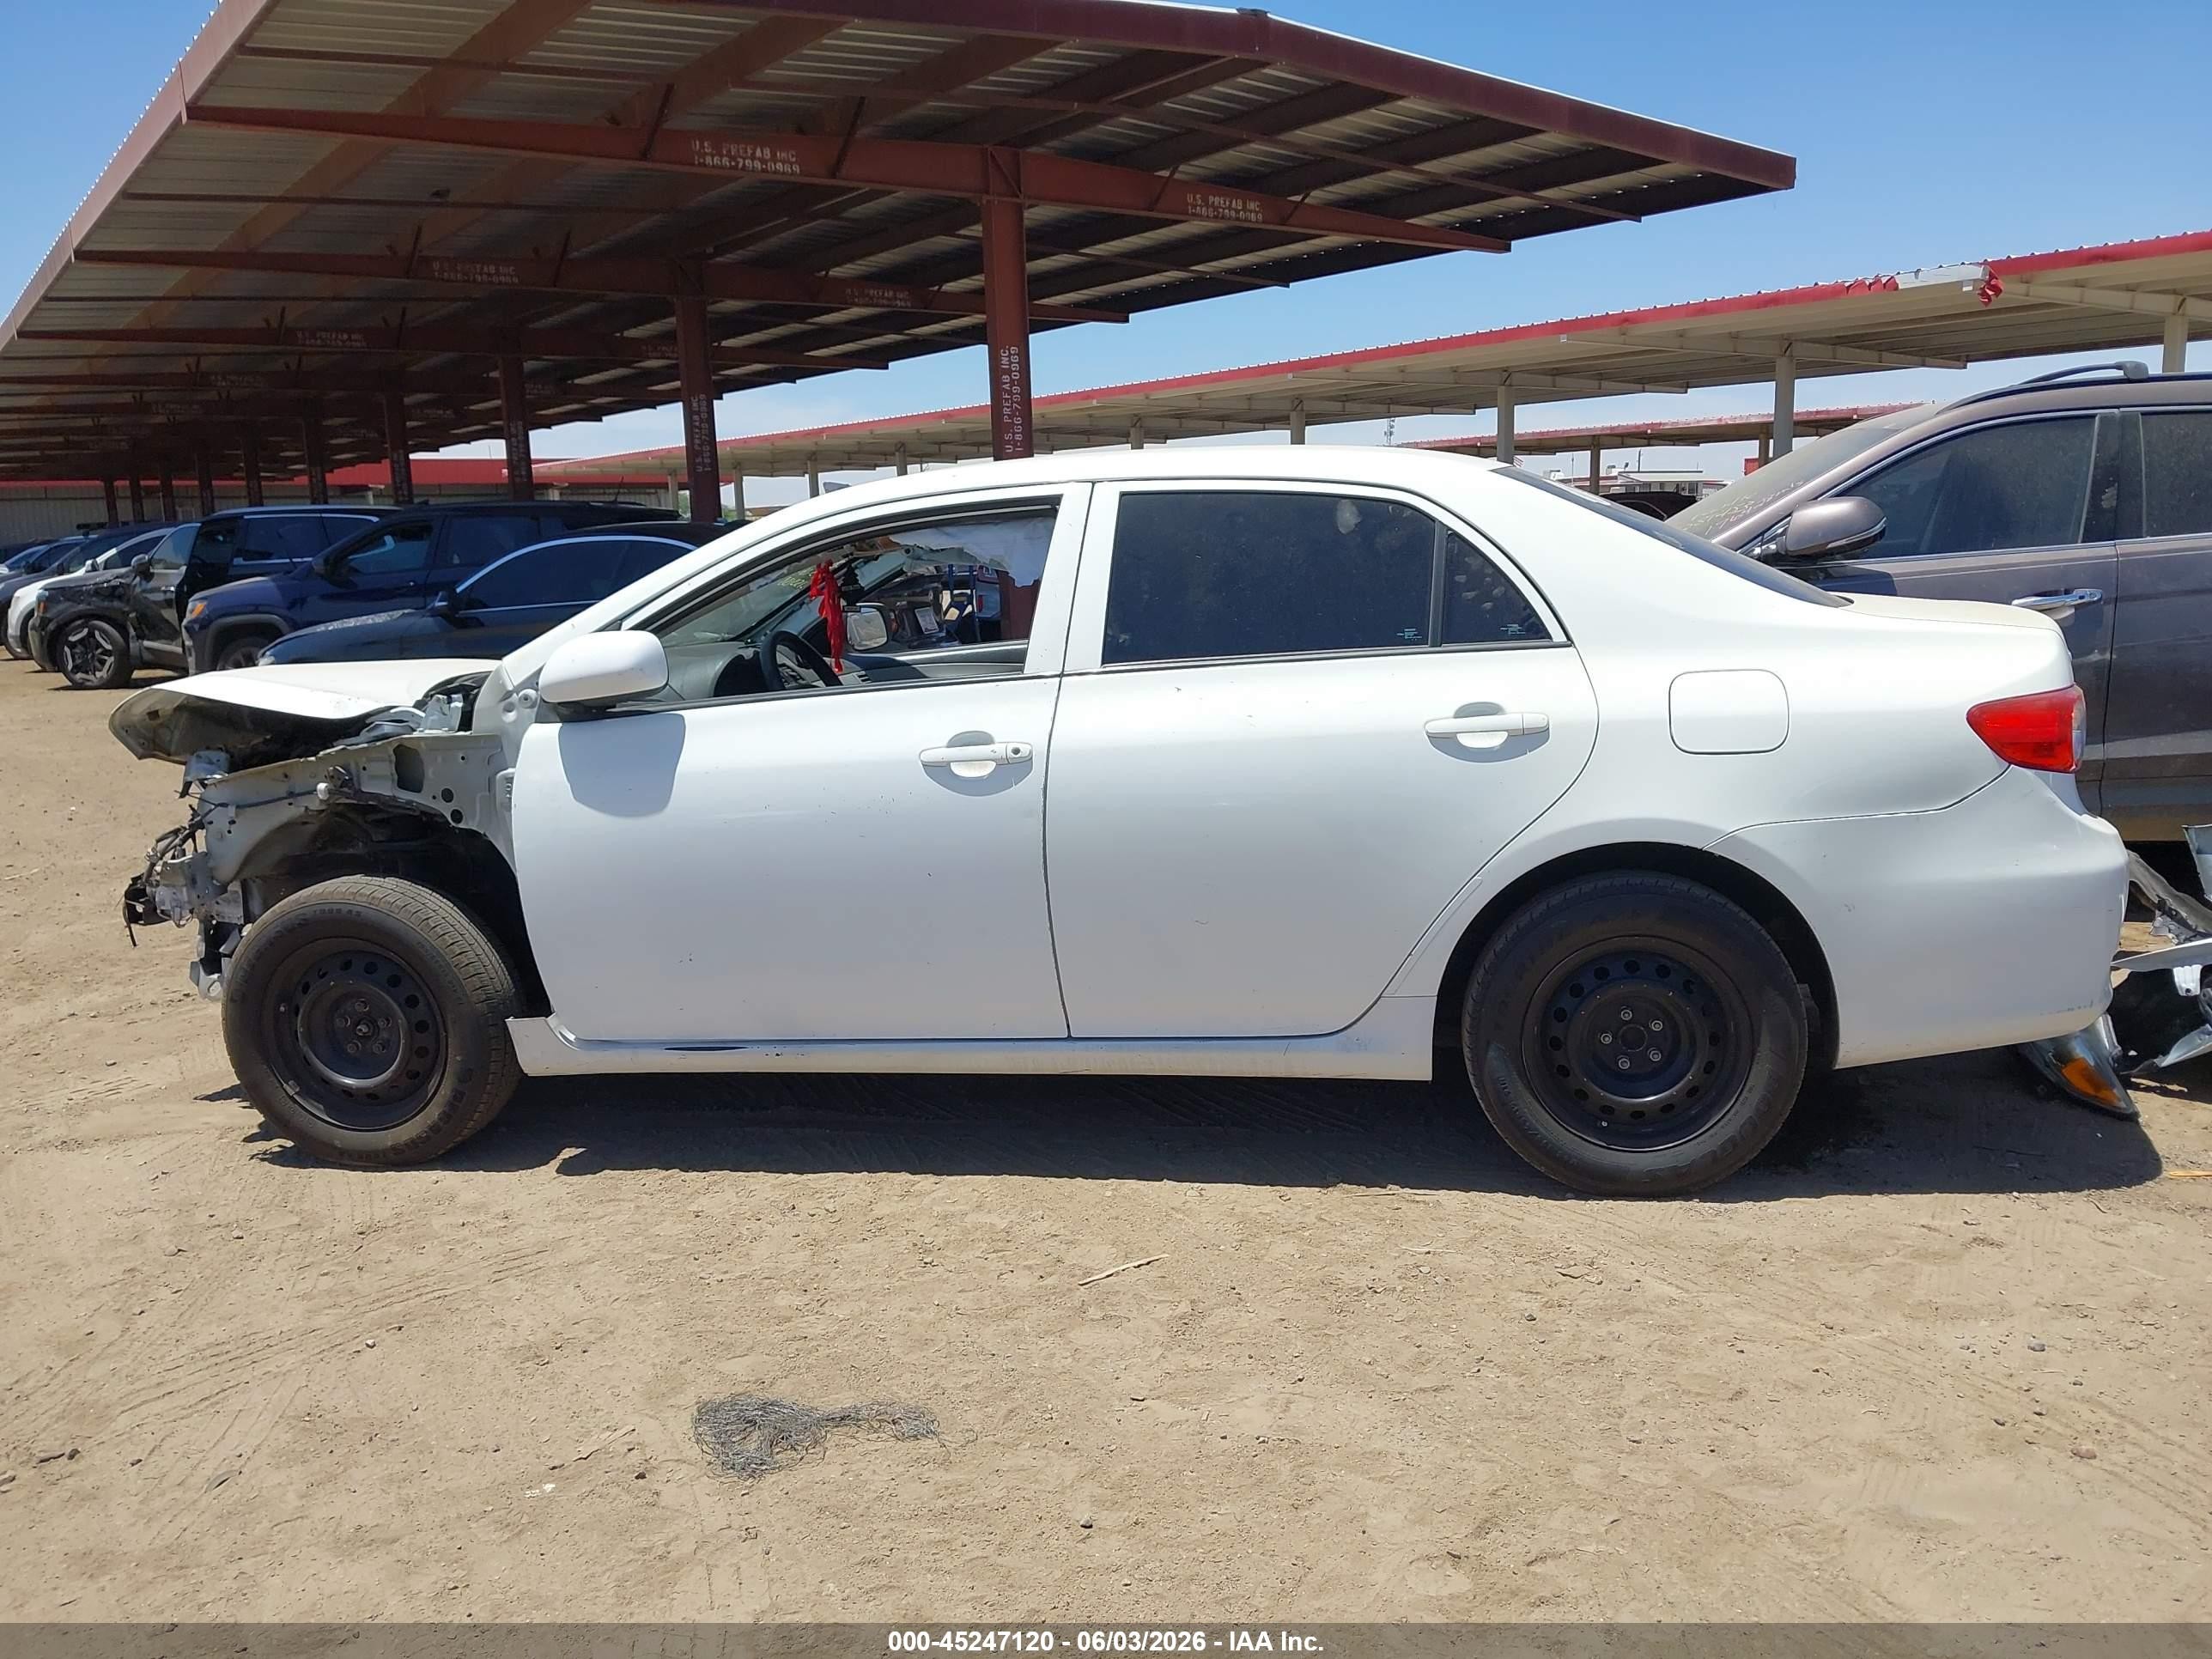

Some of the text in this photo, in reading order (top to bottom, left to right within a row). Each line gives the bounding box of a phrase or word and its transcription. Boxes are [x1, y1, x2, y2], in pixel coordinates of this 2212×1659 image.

[722, 143, 770, 160] PREFAB
[1208, 195, 1243, 210] PREFAB
[1000, 345, 1013, 453] U.S. PREFAB INC.
[1010, 346, 1024, 451] 1-866-799-0969
